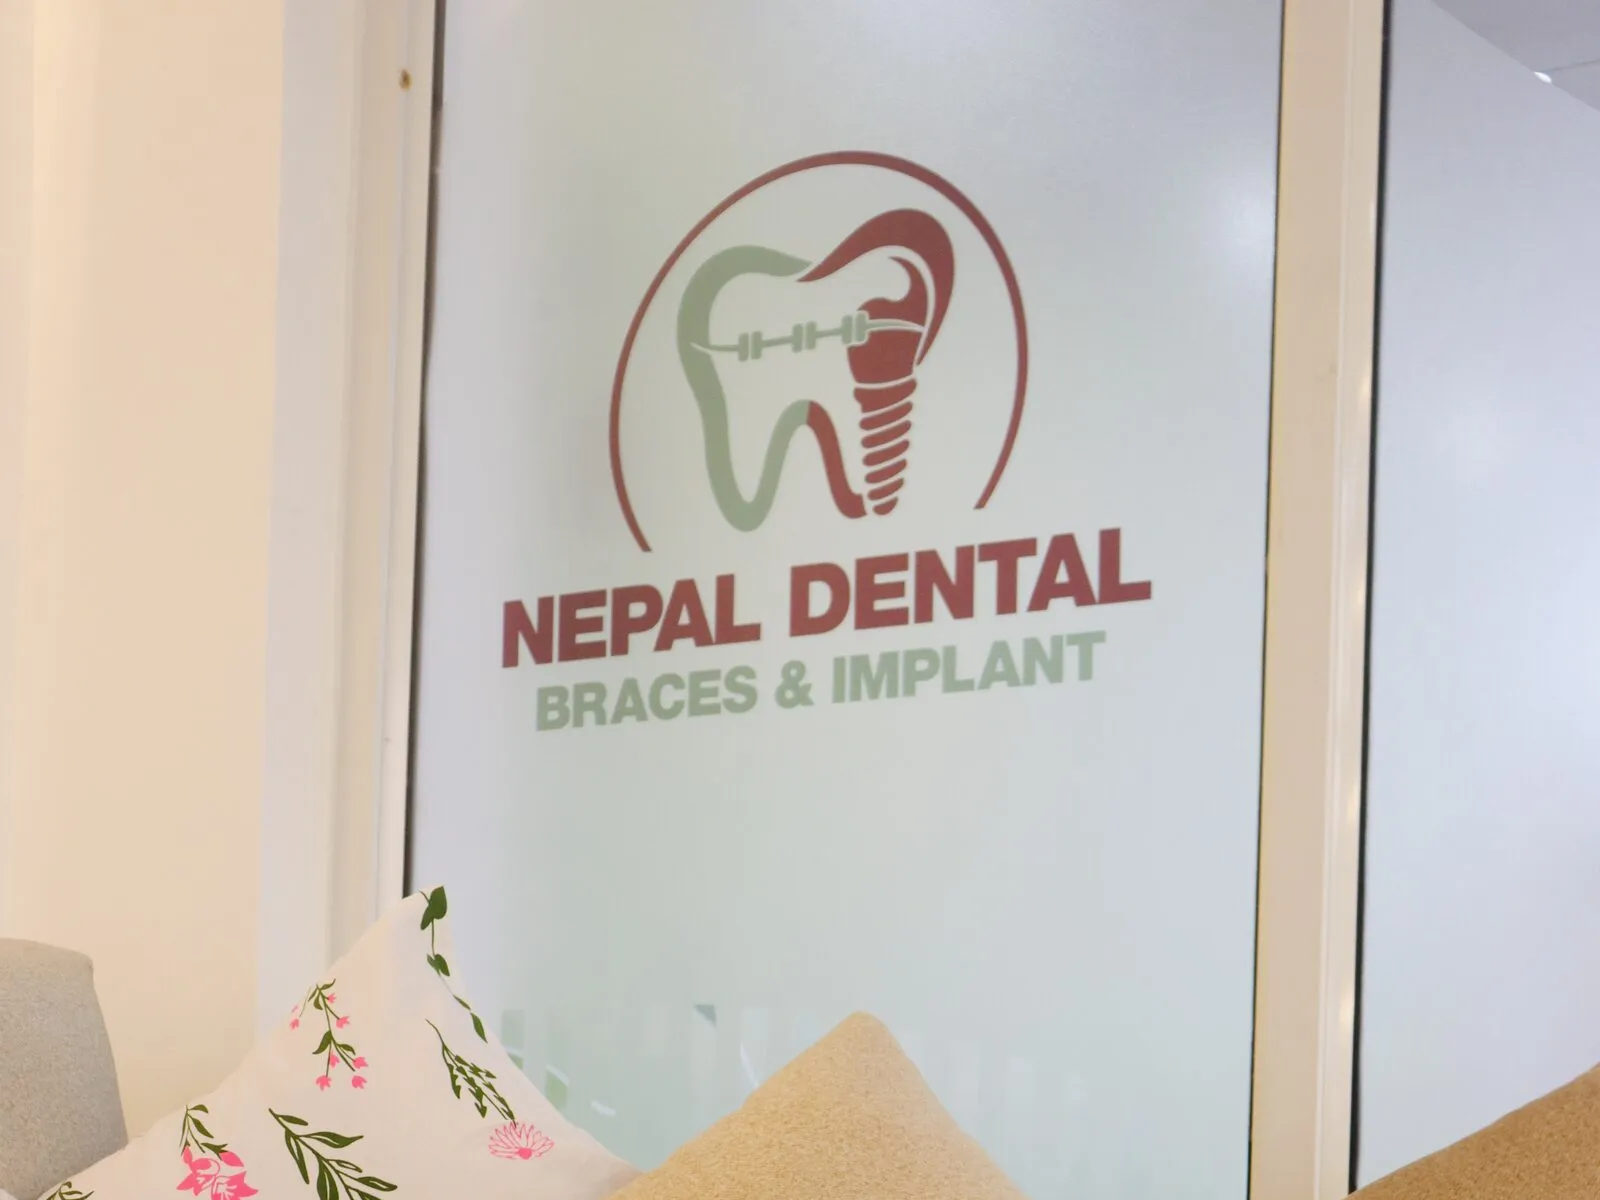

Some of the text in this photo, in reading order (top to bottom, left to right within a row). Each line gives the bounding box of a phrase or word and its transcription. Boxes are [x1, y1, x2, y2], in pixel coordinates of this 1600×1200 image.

[502, 527, 1152, 669] NEPAL DENTAL
[535, 630, 1106, 731] BRACES & IMPLANT
